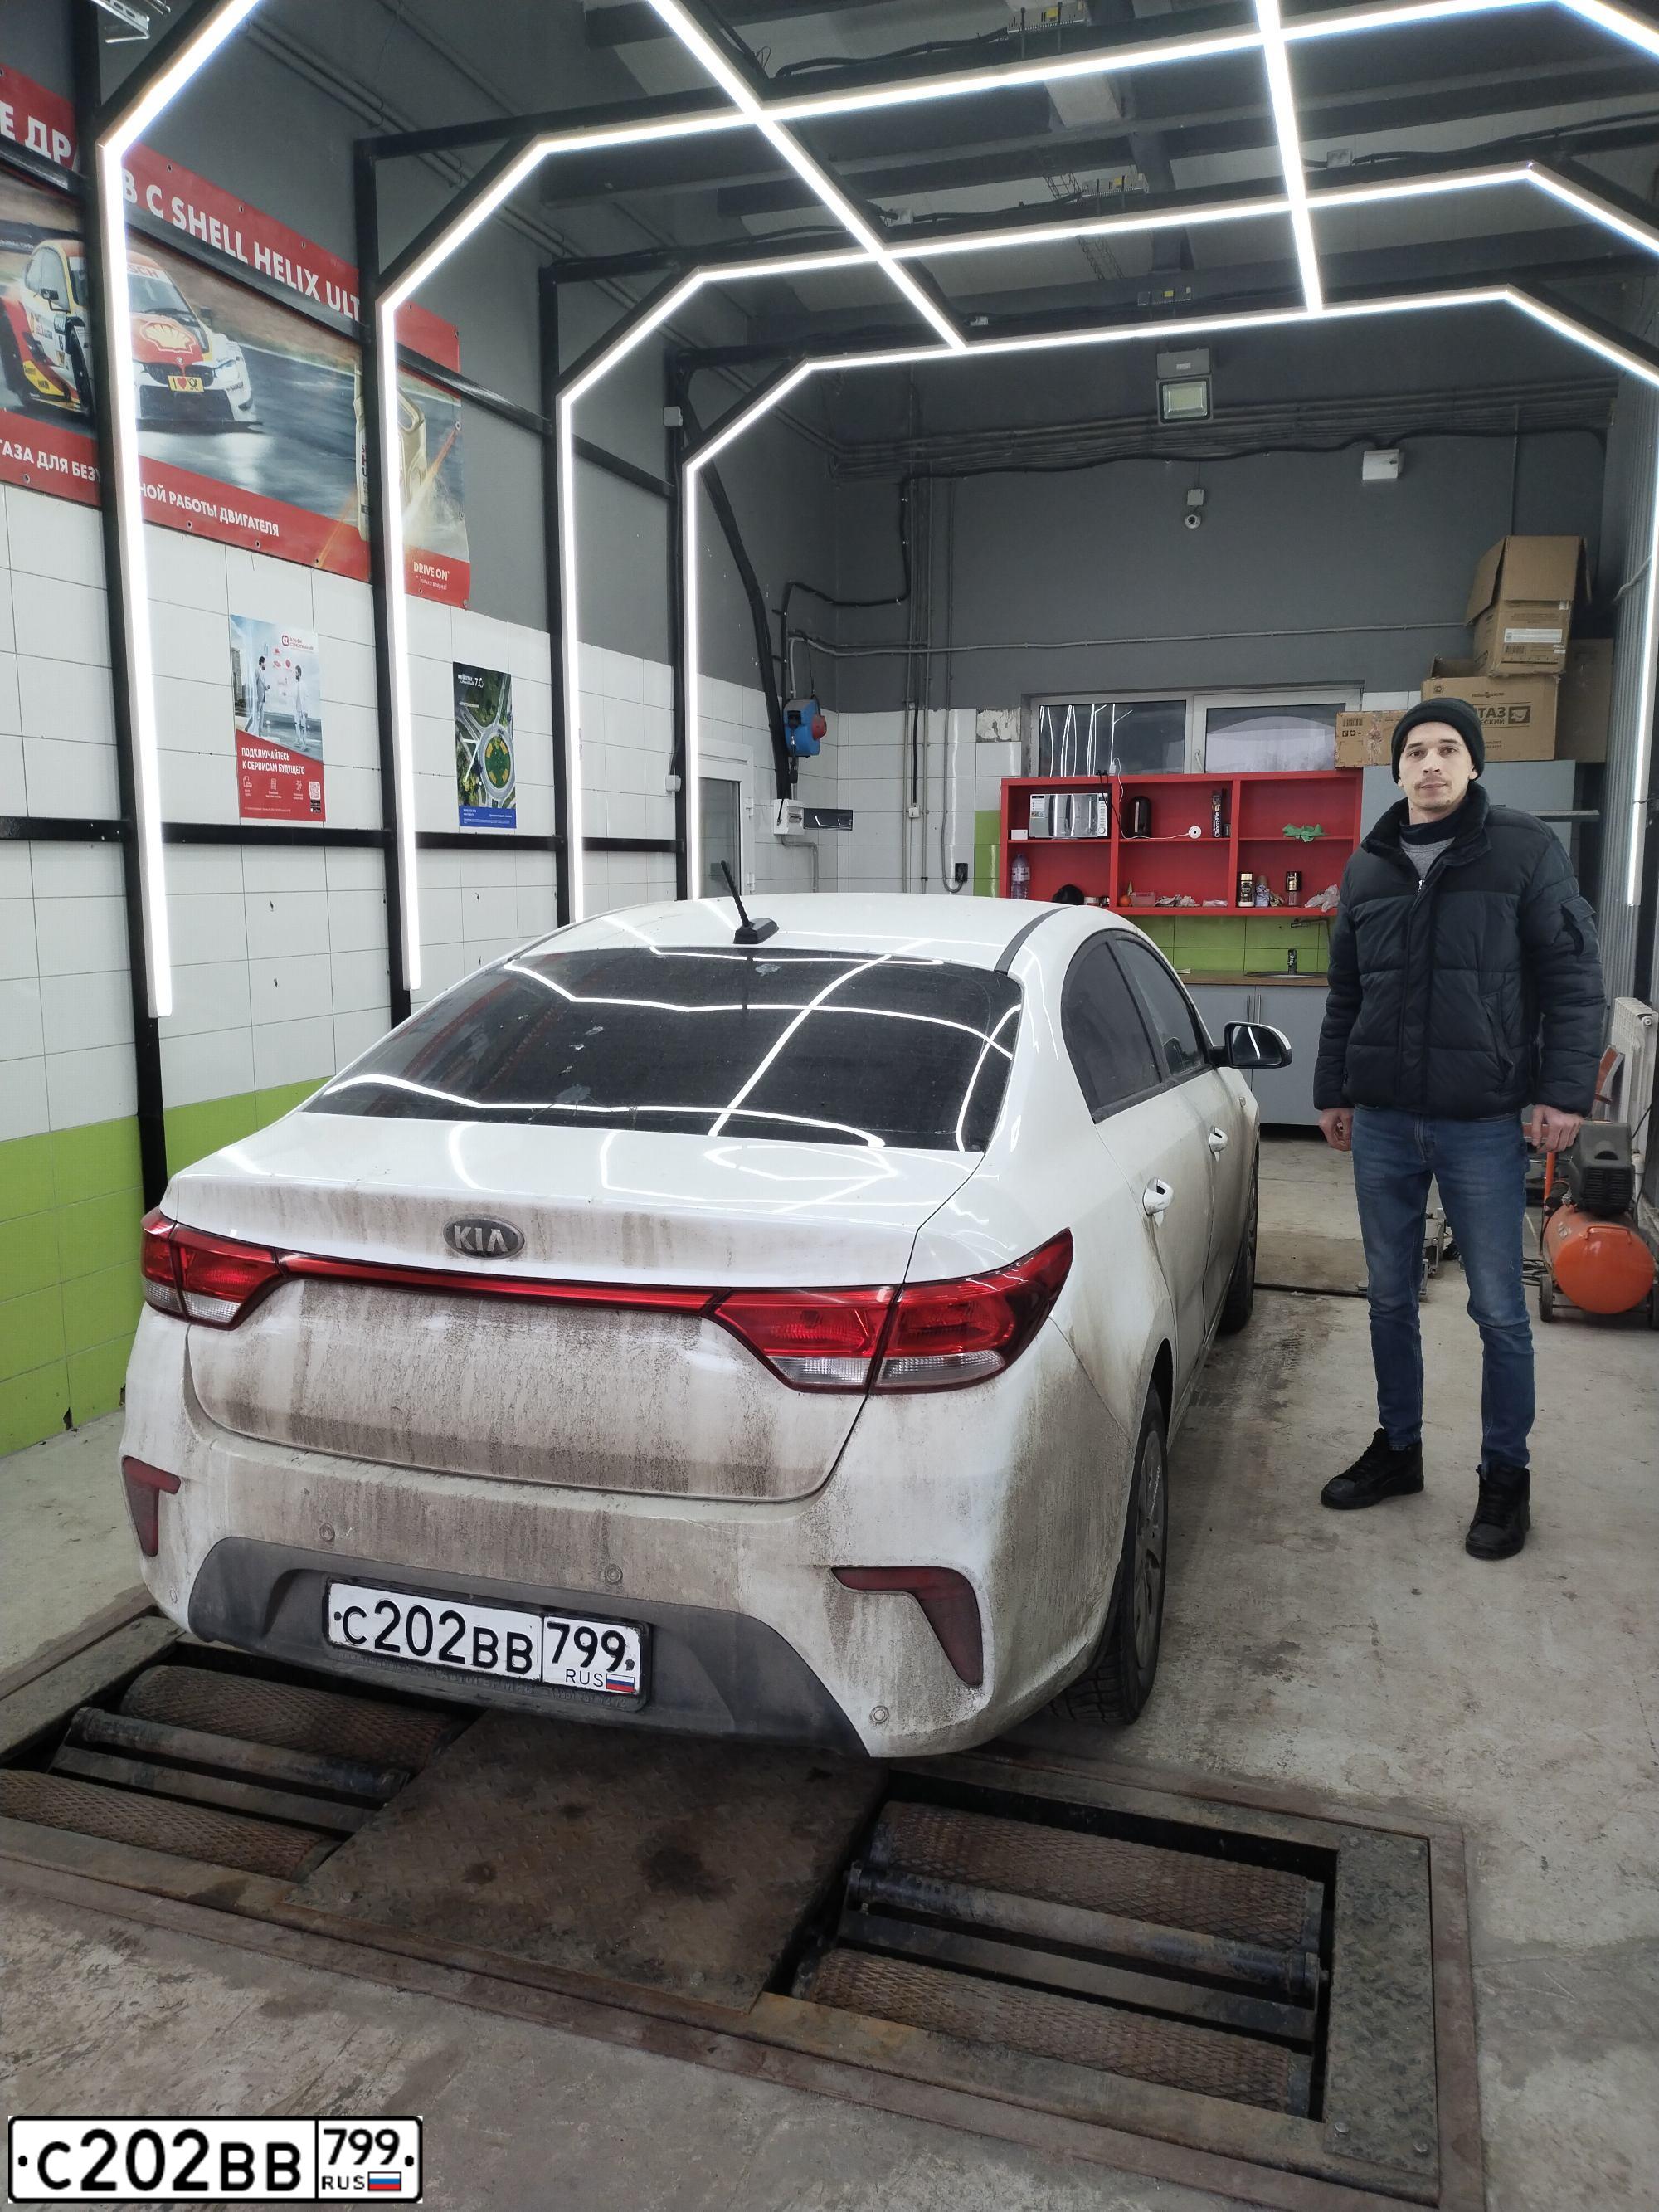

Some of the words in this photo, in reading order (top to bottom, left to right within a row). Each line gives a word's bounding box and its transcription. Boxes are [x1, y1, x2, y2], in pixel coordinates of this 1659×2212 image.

[0, 100, 16, 140] Е
[25, 115, 72, 164] ДР
[122, 168, 138, 204] В
[146, 184, 163, 219] С
[171, 197, 247, 264] SHELL
[254, 241, 321, 302] HELIX
[326, 280, 360, 322] ULT
[37, 451, 68, 474] ДЛЯ
[71, 461, 98, 482] БЕЗ
[139, 483, 167, 503] НОЙ
[168, 491, 217, 519] РАБОТЫ
[220, 506, 280, 537] ДВИГАТЕЛЯ
[413, 561, 435, 577] DRIVE
[1477, 706, 1506, 719] ТАЗ
[241, 748, 290, 761] ПОДКЛЮЧАЙТЕСЬ
[242, 761, 246, 770] К
[247, 761, 278, 772] СЕРВИСАМ
[279, 764, 305, 775] БУДУЩЕГО
[454, 1225, 508, 1252] KIA
[547, 1622, 626, 1672] 799
[566, 1669, 604, 1688] RUS
